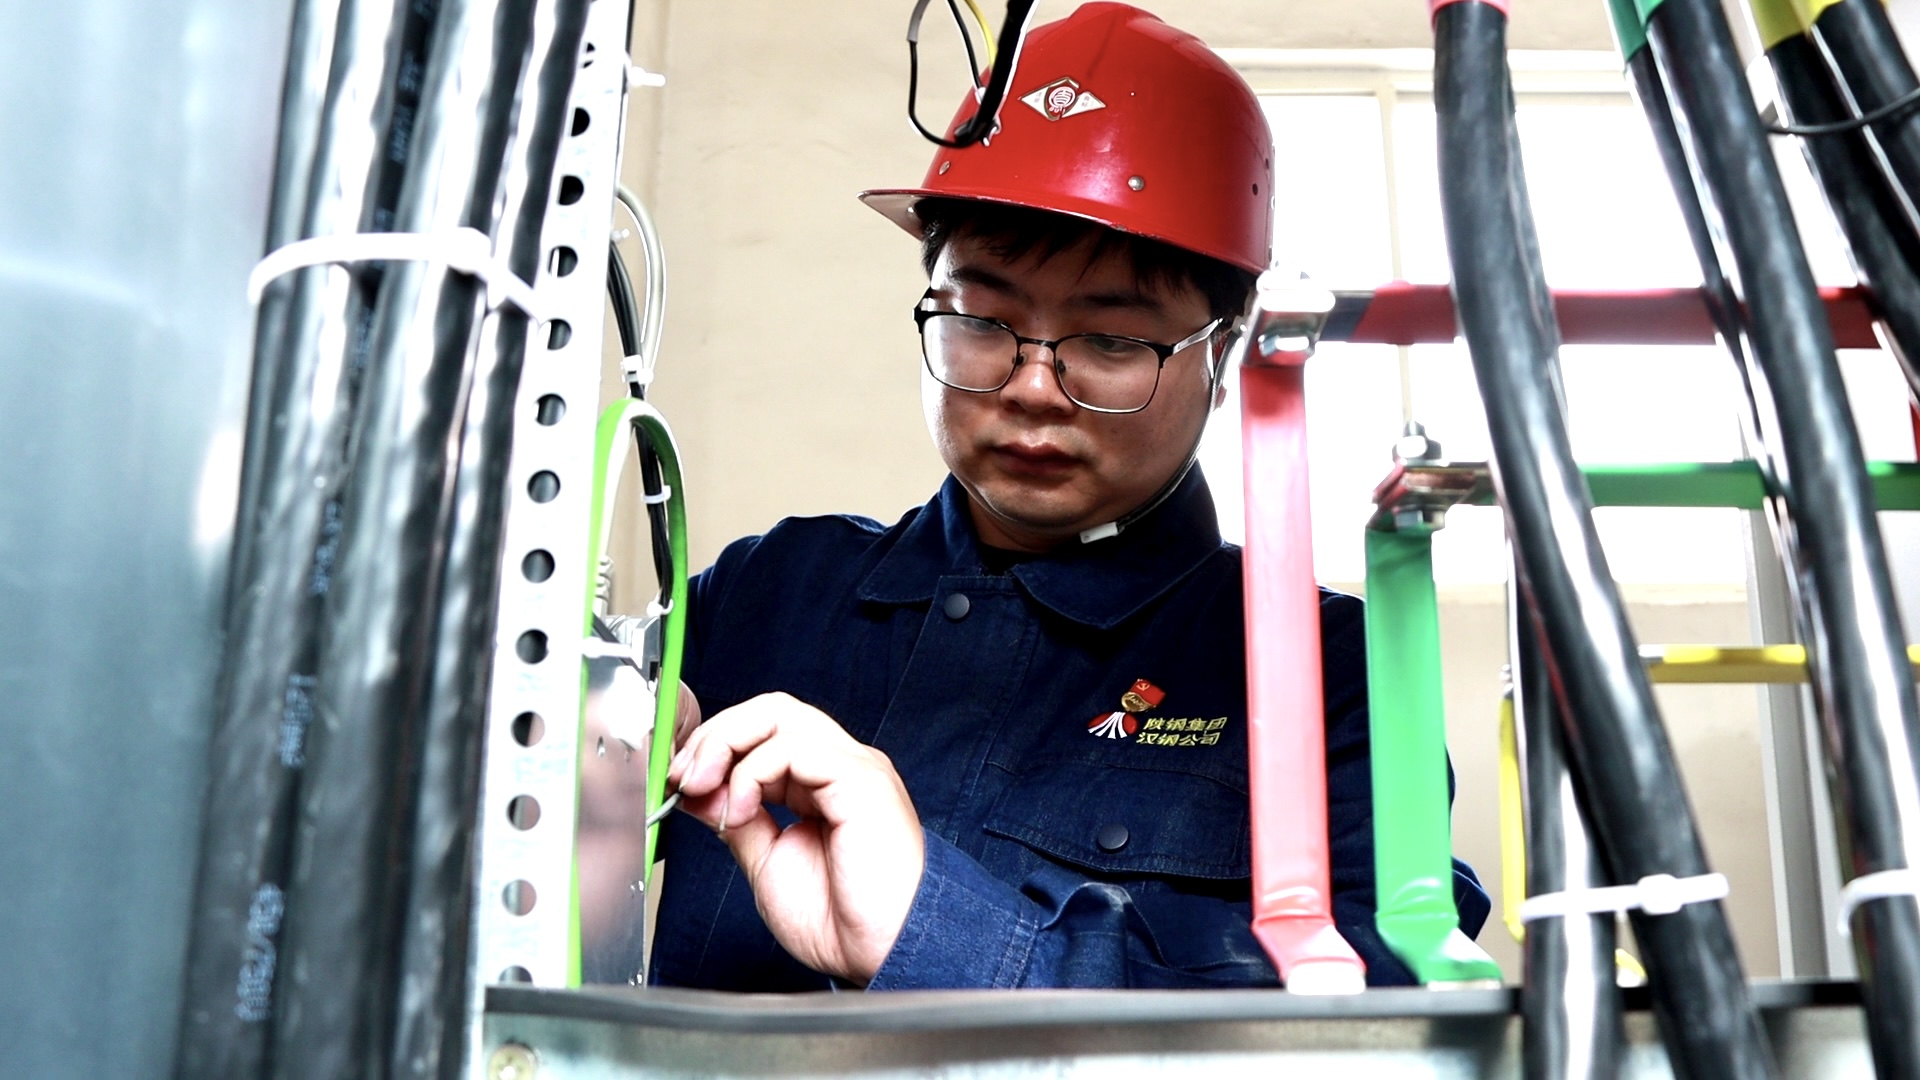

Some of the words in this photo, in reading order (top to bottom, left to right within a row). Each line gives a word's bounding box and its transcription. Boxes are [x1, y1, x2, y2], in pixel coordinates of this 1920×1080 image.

[1143, 717, 1228, 731] 陕钢集团
[1136, 731, 1220, 746] 汉钢公司
